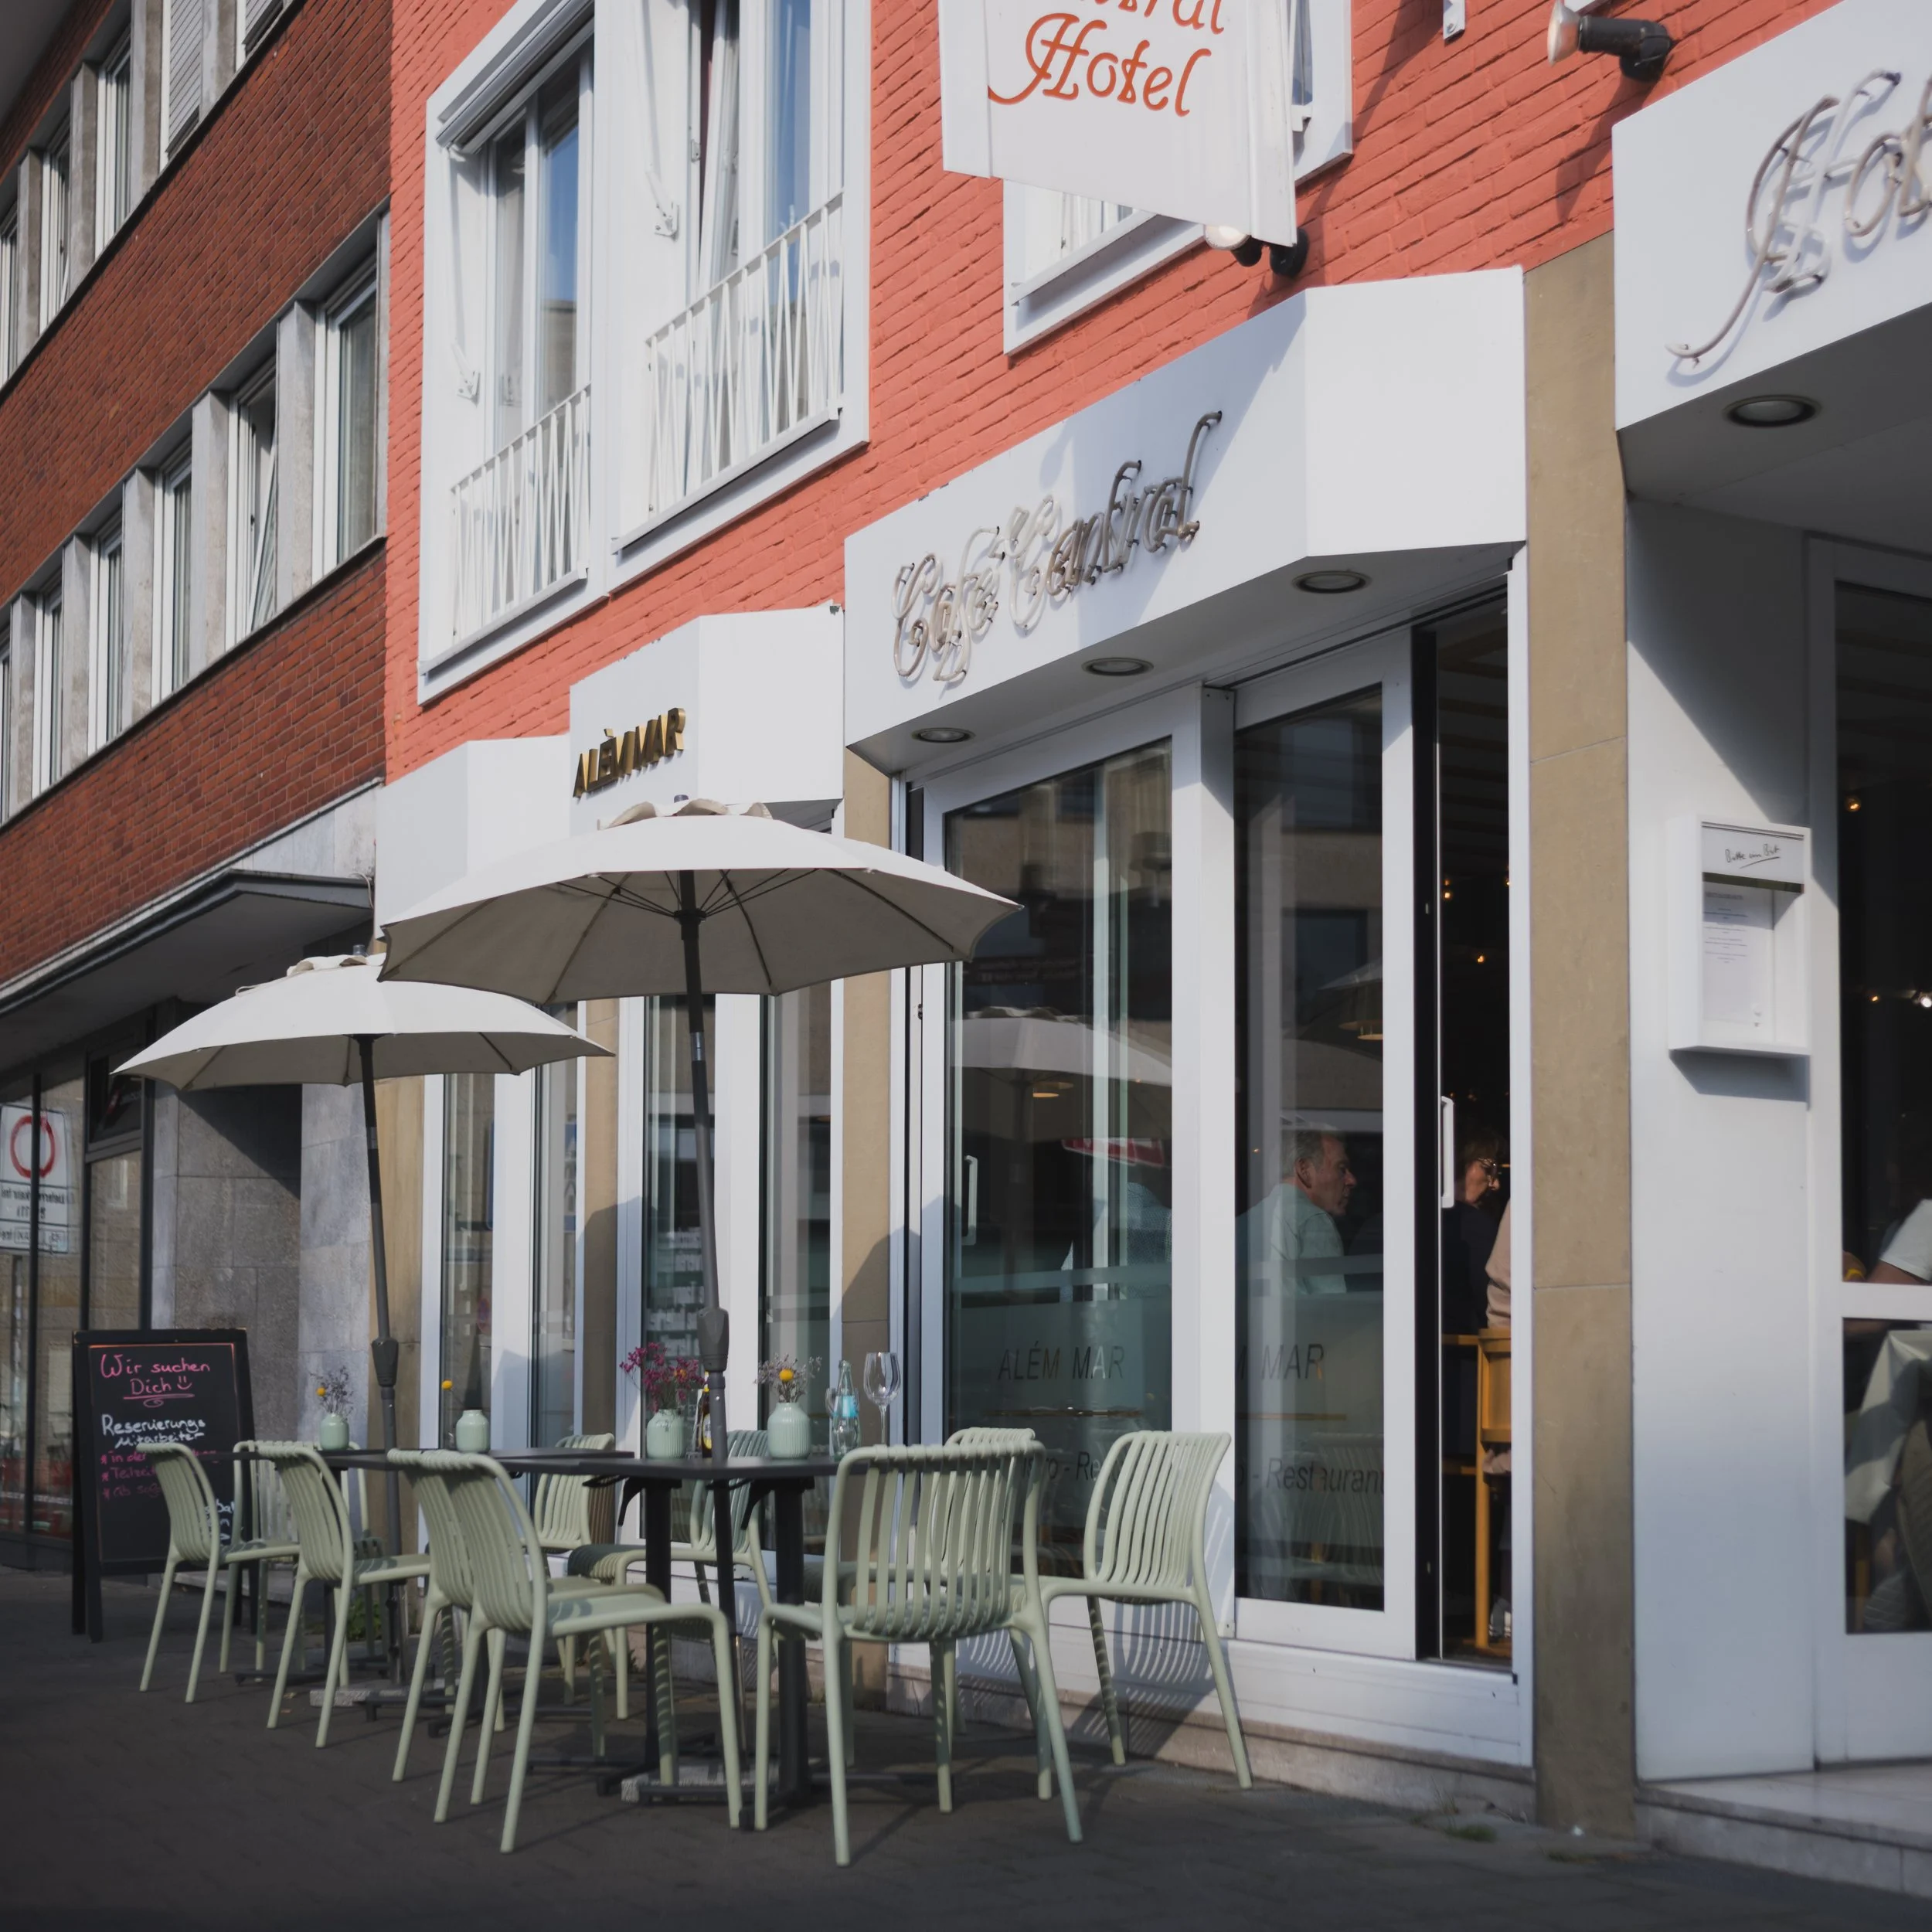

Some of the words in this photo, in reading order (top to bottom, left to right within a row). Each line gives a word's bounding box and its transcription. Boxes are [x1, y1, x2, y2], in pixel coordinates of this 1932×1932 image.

[988, 12, 1212, 117] Hotel
[1005, 410, 1223, 630] Central
[100, 1353, 142, 1379] Wir
[151, 1357, 210, 1374] suchen
[998, 1341, 1061, 1380] ALÉM
[1072, 1345, 1125, 1379] MAR
[1261, 1343, 1325, 1380] MAR
[129, 1377, 172, 1396] Dich
